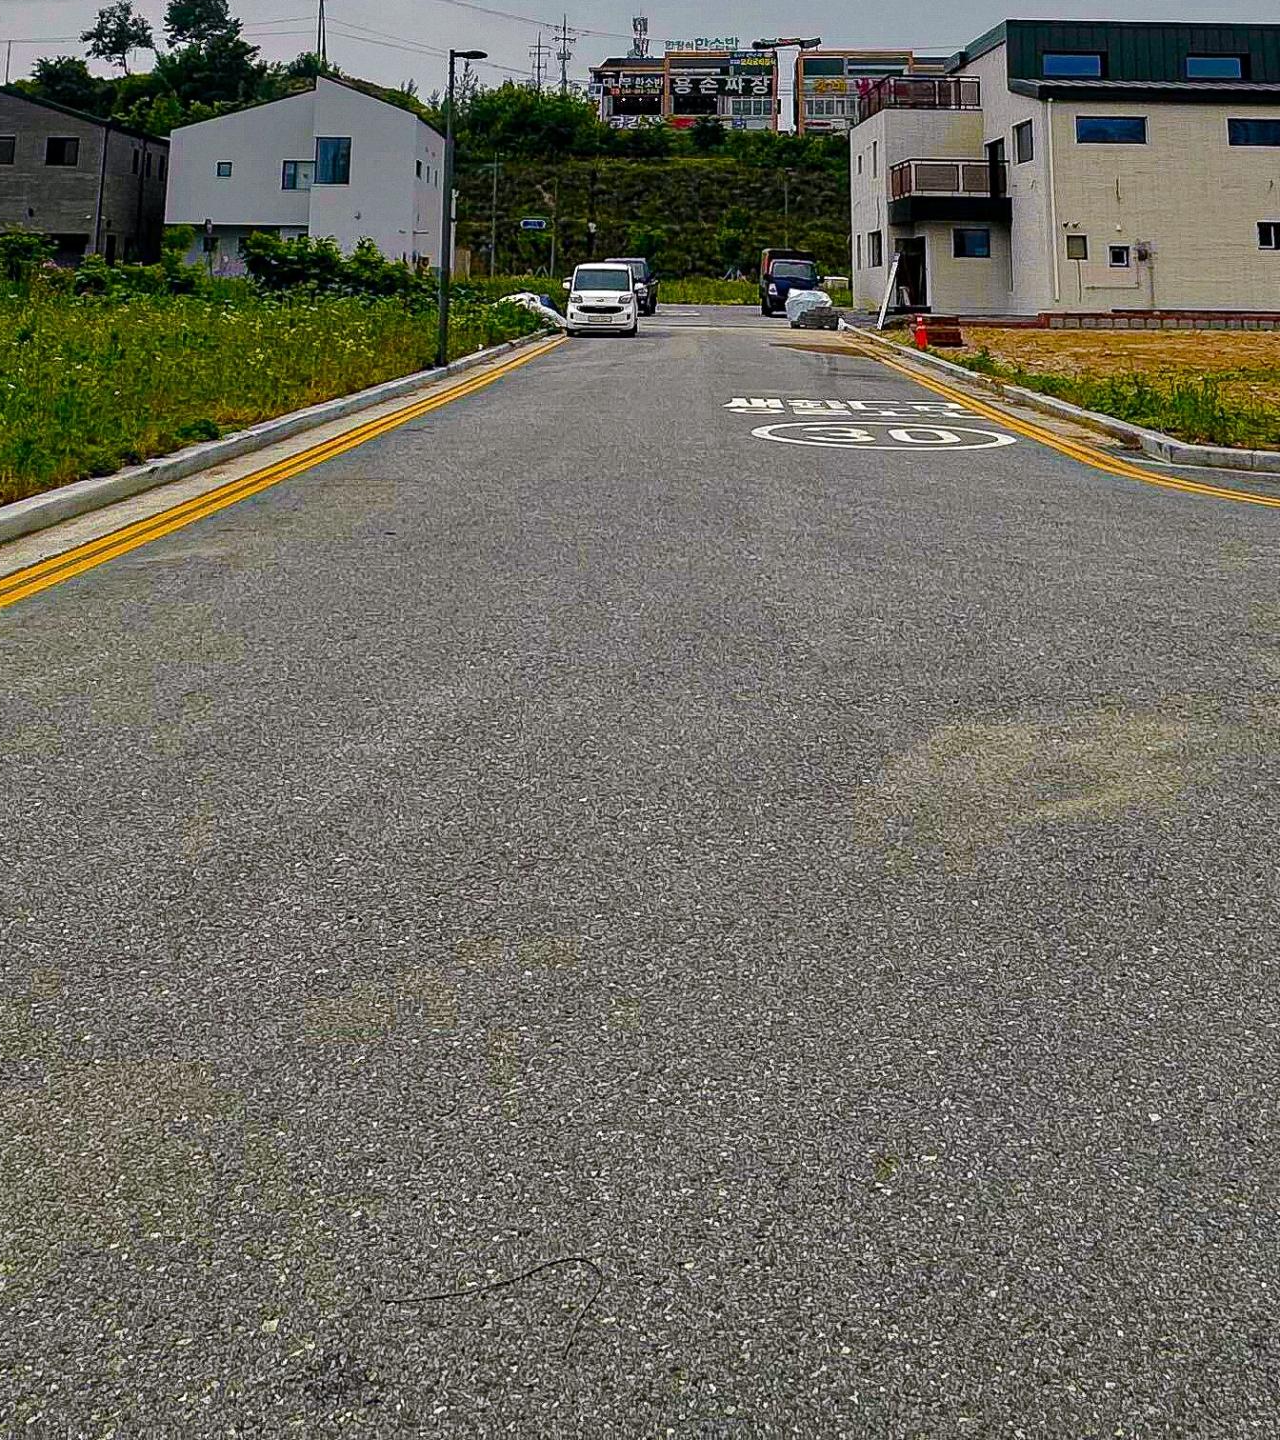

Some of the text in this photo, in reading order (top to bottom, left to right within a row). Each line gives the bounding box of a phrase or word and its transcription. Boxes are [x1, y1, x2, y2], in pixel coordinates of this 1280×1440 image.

[695, 36, 740, 51] 한소반
[602, 77, 632, 88] 대나무
[801, 427, 962, 444] 30
